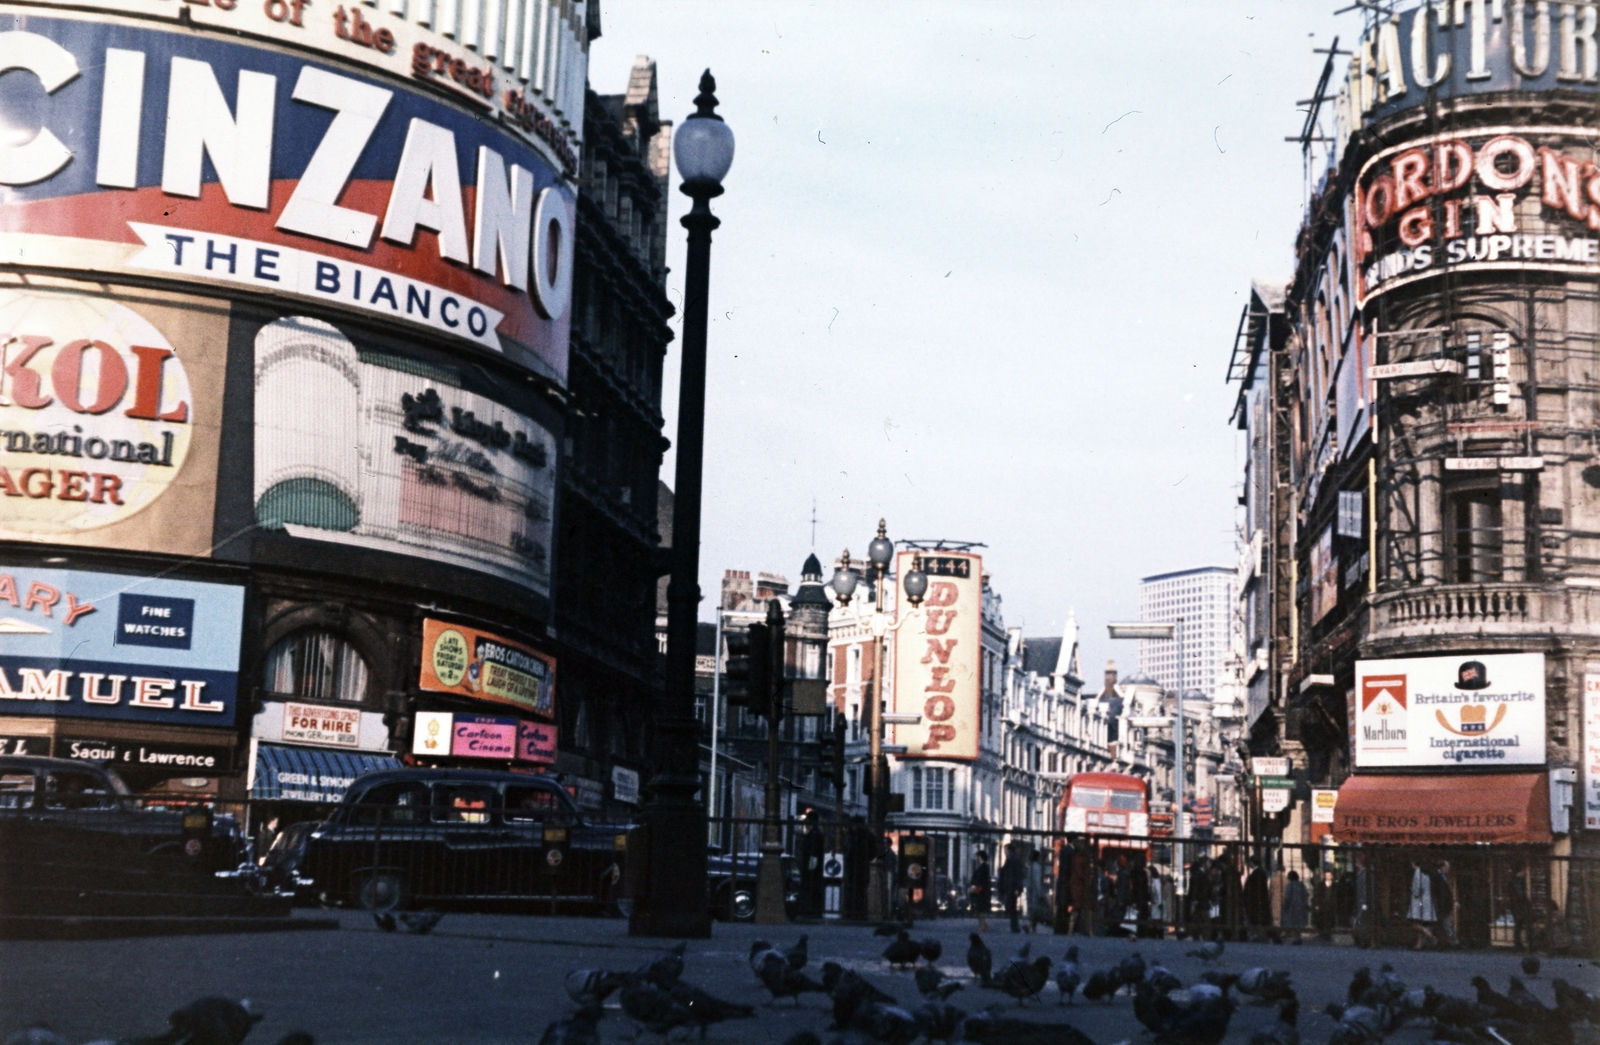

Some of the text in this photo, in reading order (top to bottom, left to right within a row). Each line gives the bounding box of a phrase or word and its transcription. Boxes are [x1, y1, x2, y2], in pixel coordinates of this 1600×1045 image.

[264, 0, 304, 28] of
[333, 5, 397, 54] the
[411, 41, 495, 98] great
[0, 31, 571, 320] CINZANO
[1400, 194, 1518, 246] GIN
[1449, 234, 1599, 265] SUPREME
[165, 233, 488, 338] THE BIANCO
[0, 424, 174, 467] national
[142, 605, 171, 618] FINE
[124, 623, 187, 637] WATCHES
[485, 642, 505, 662] EROS
[920, 580, 960, 750] DUNLOP
[1414, 691, 1535, 704] Britain's favourite
[291, 717, 352, 733] FOR HIRE
[457, 727, 503, 740] Cartoon
[1363, 718, 1407, 741] Marlboro
[468, 740, 511, 753] Cinema
[1429, 735, 1520, 749] International
[139, 747, 215, 767] Lawrence
[1443, 748, 1506, 762] cigarette
[278, 772, 308, 785] GREEN
[311, 776, 317, 786] &
[1343, 813, 1515, 829] THE EROS JEWELLERS
